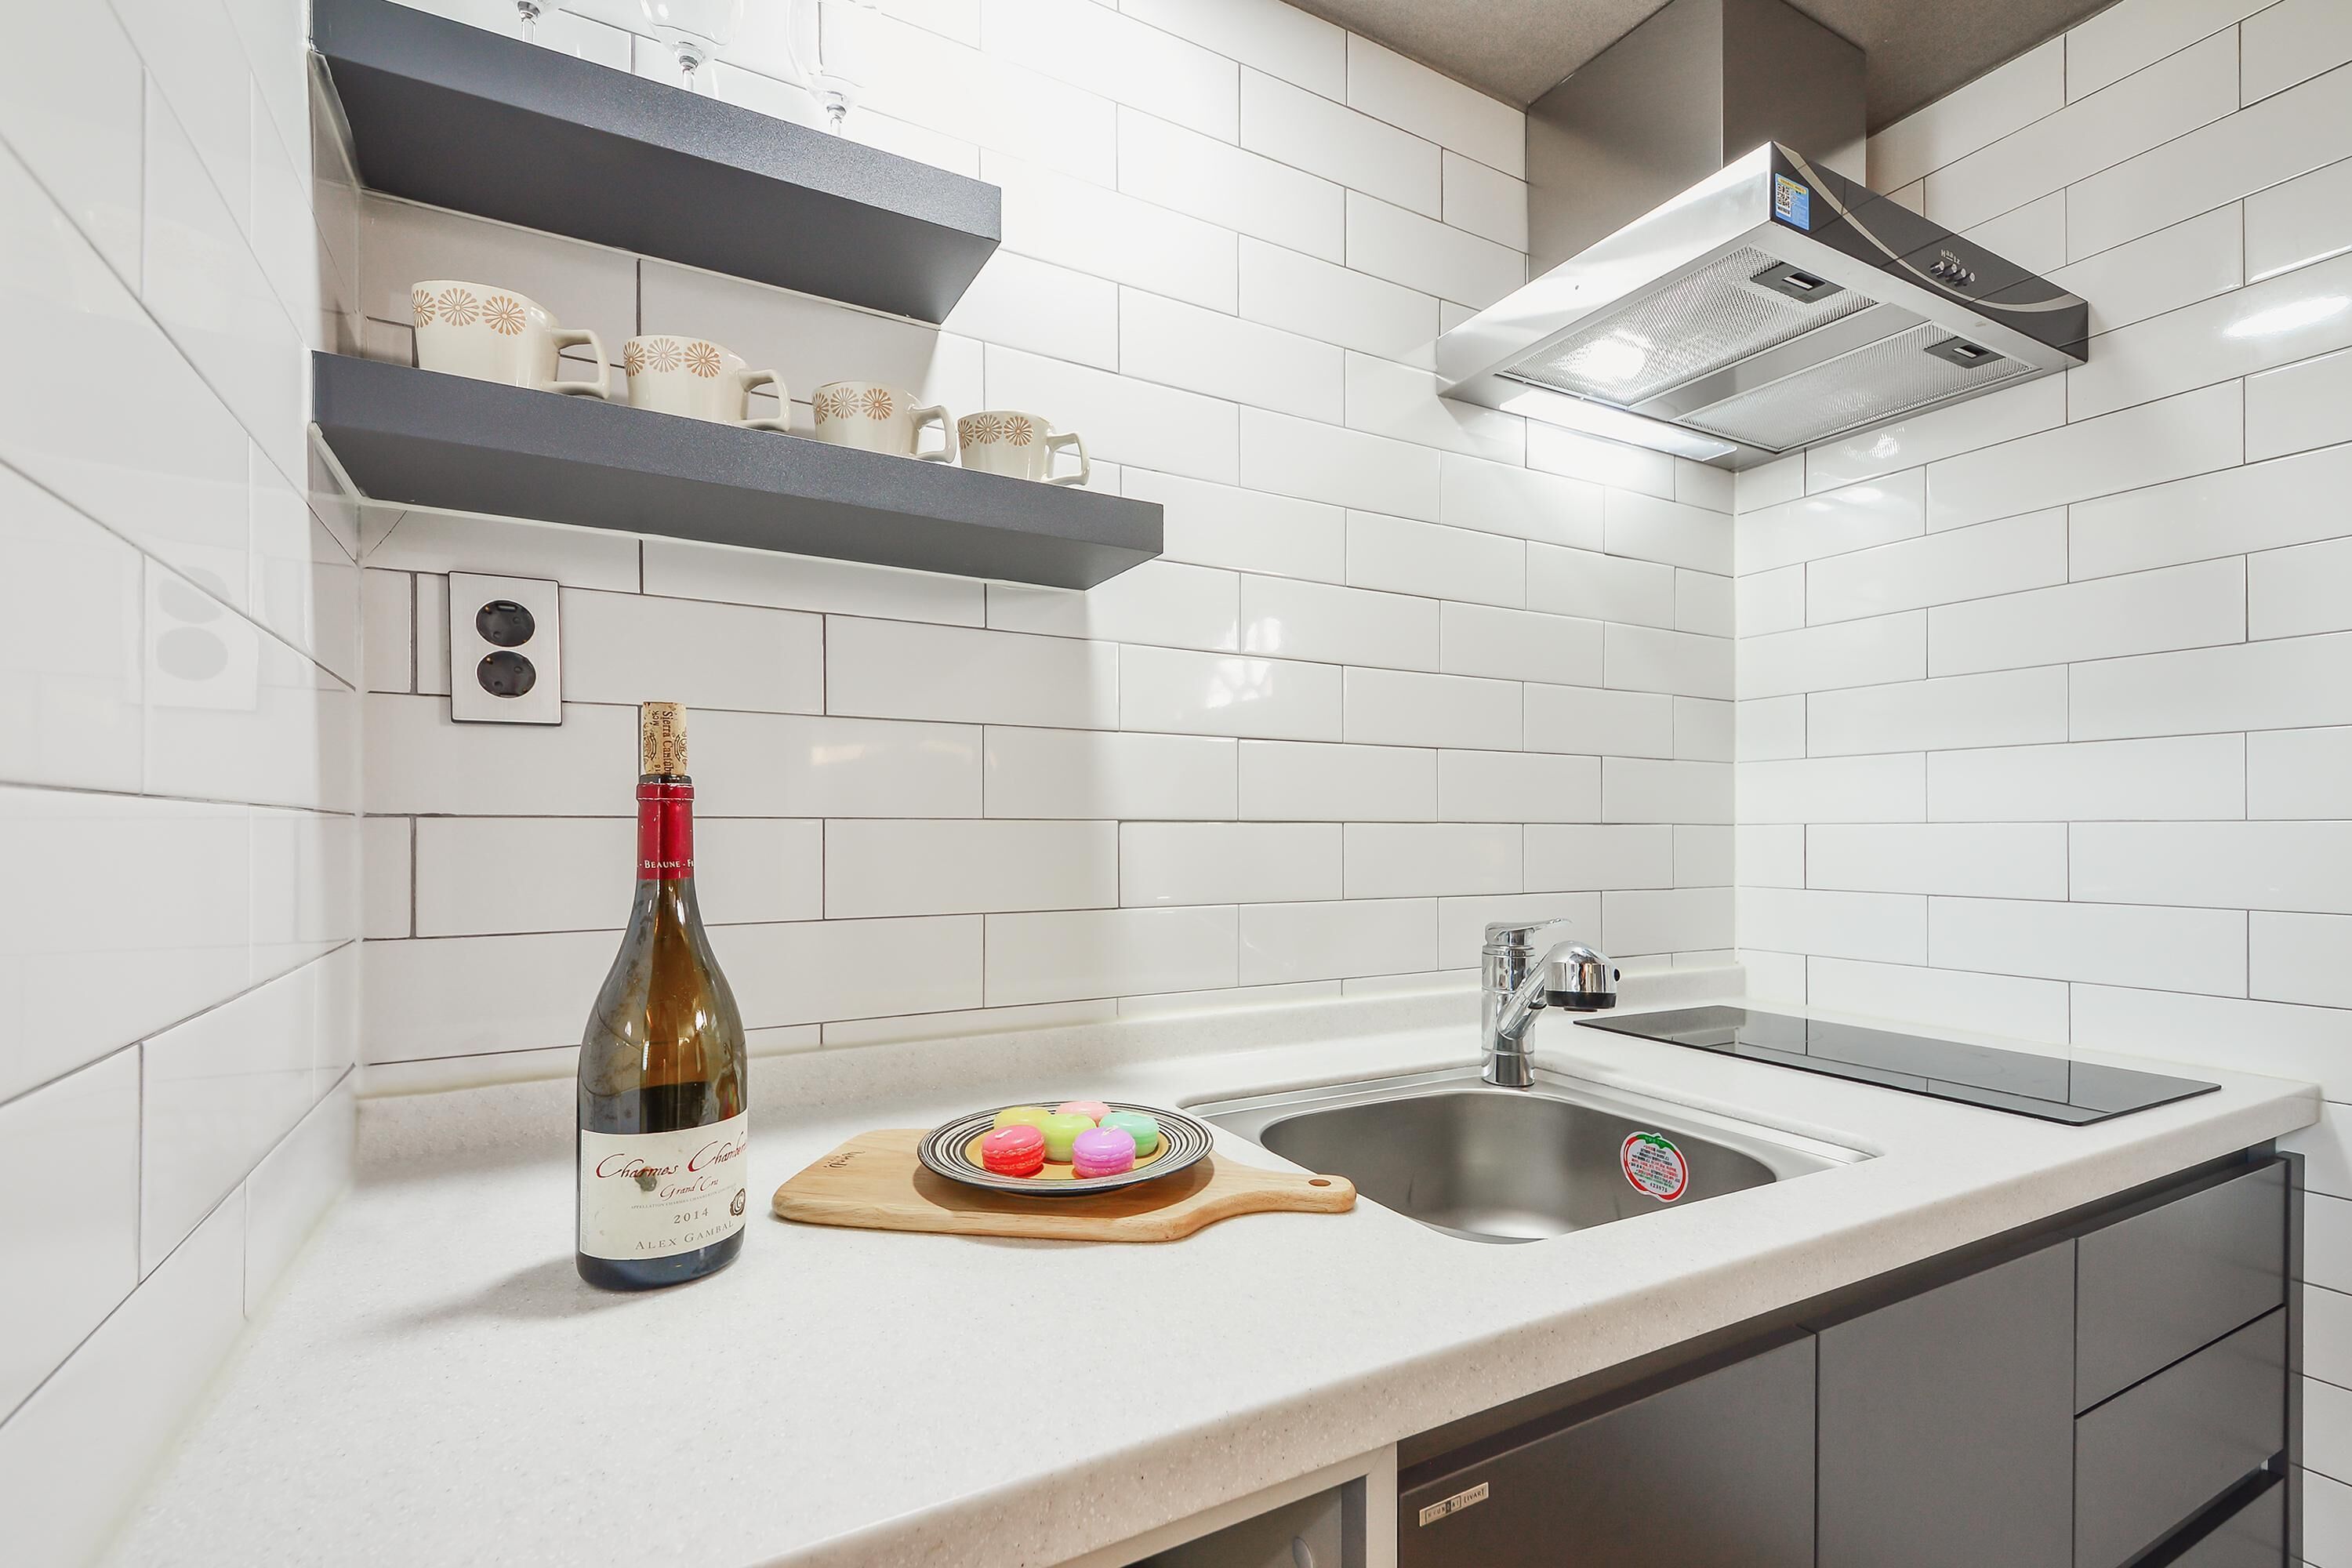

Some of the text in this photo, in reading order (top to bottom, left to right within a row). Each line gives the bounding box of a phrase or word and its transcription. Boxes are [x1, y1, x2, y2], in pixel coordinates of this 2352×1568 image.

[1940, 249, 1961, 265] Haatz
[662, 710, 673, 738] Sierra
[644, 859, 681, 869] BEAUNE
[596, 1153, 679, 1178] Charmes
[659, 1176, 703, 1201] Grand
[699, 1176, 719, 1191] Cru
[673, 1207, 710, 1224] 2014
[634, 1220, 734, 1250] ALEX GAMBAL
[1463, 1488, 1484, 1504] LIVART
